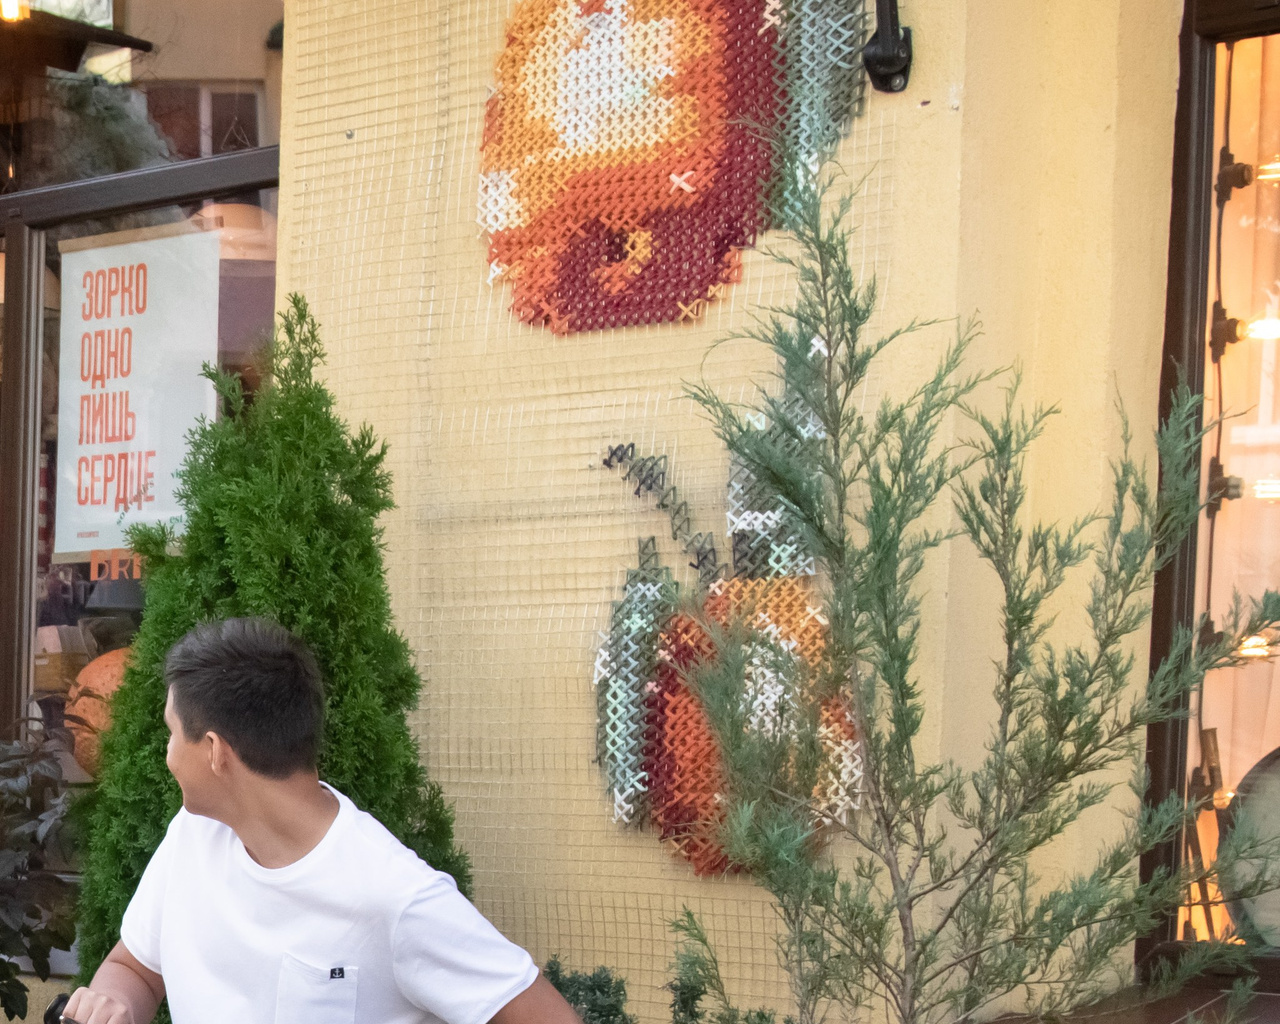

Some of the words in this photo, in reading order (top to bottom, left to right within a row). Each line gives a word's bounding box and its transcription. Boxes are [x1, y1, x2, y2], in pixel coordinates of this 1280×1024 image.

[81, 263, 147, 321] ЗОРКО
[80, 327, 132, 389] ОДНО
[78, 390, 136, 445] ЛИШЬ
[77, 450, 156, 513] СЕРДЦЕ
